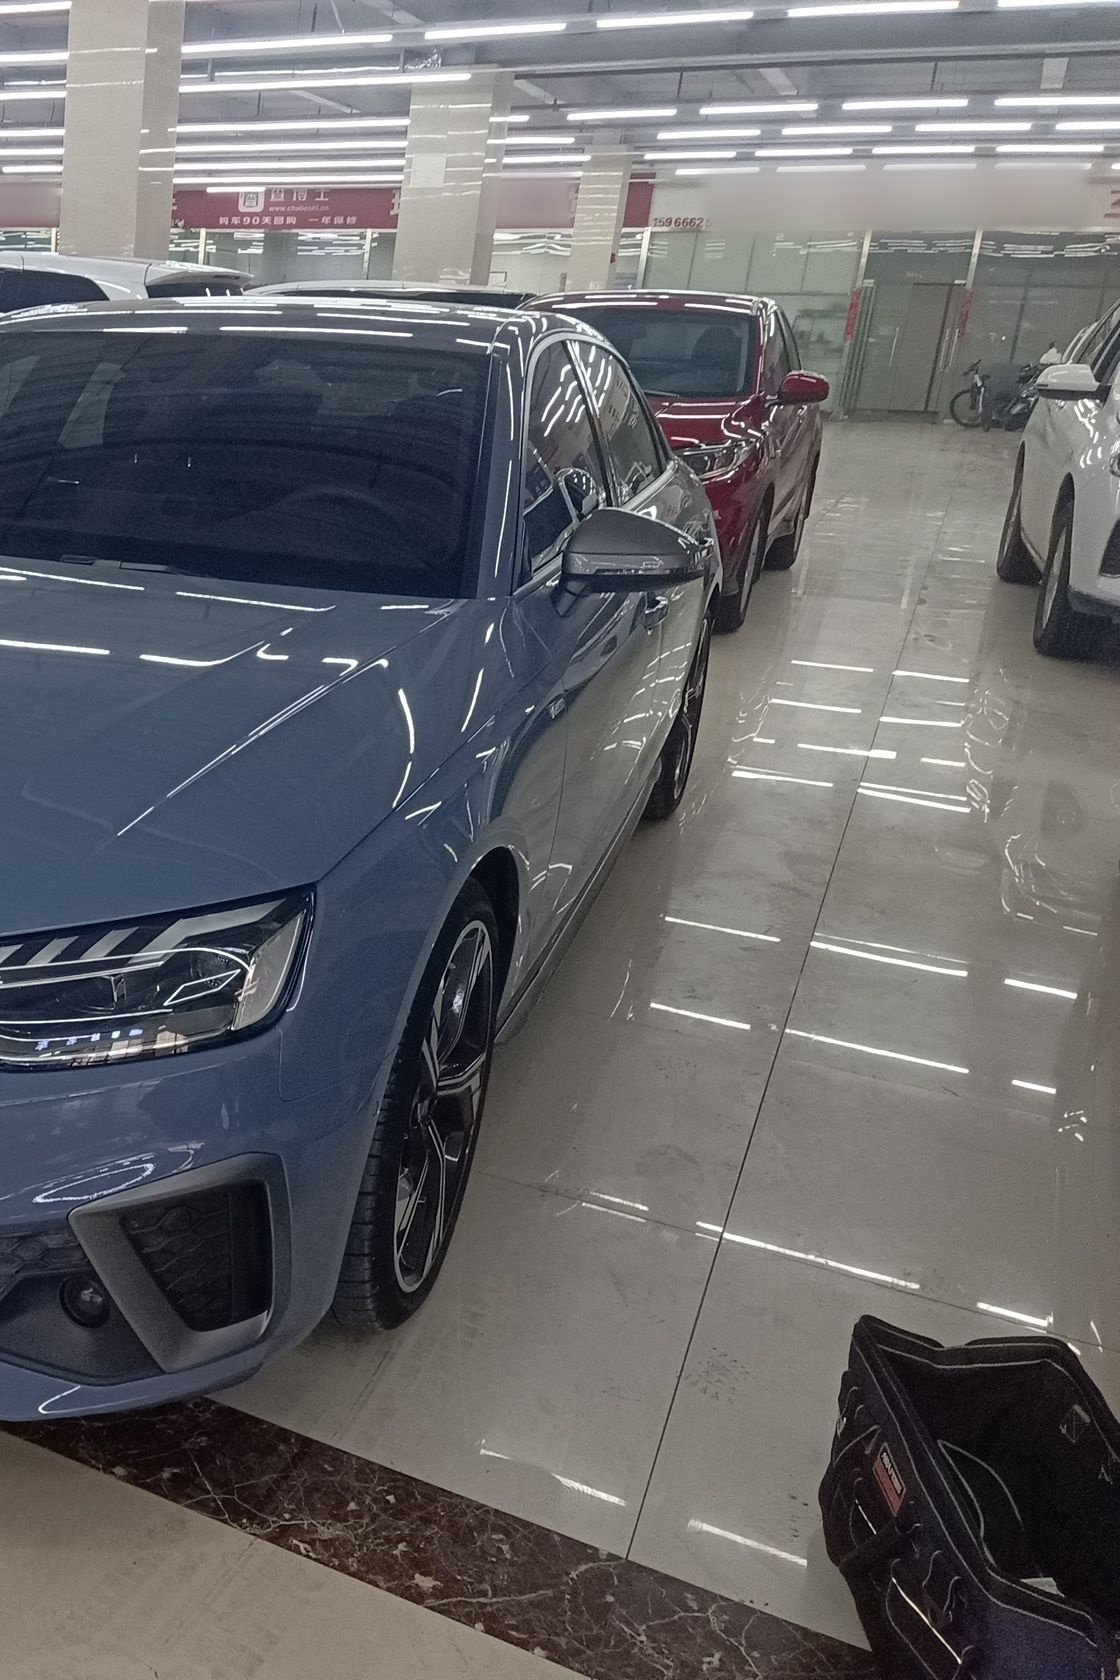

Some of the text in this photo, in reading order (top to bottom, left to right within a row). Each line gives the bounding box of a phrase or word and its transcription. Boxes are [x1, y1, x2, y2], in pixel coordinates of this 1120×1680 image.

[219, 215, 357, 225] 购车90天回购 一年保修
